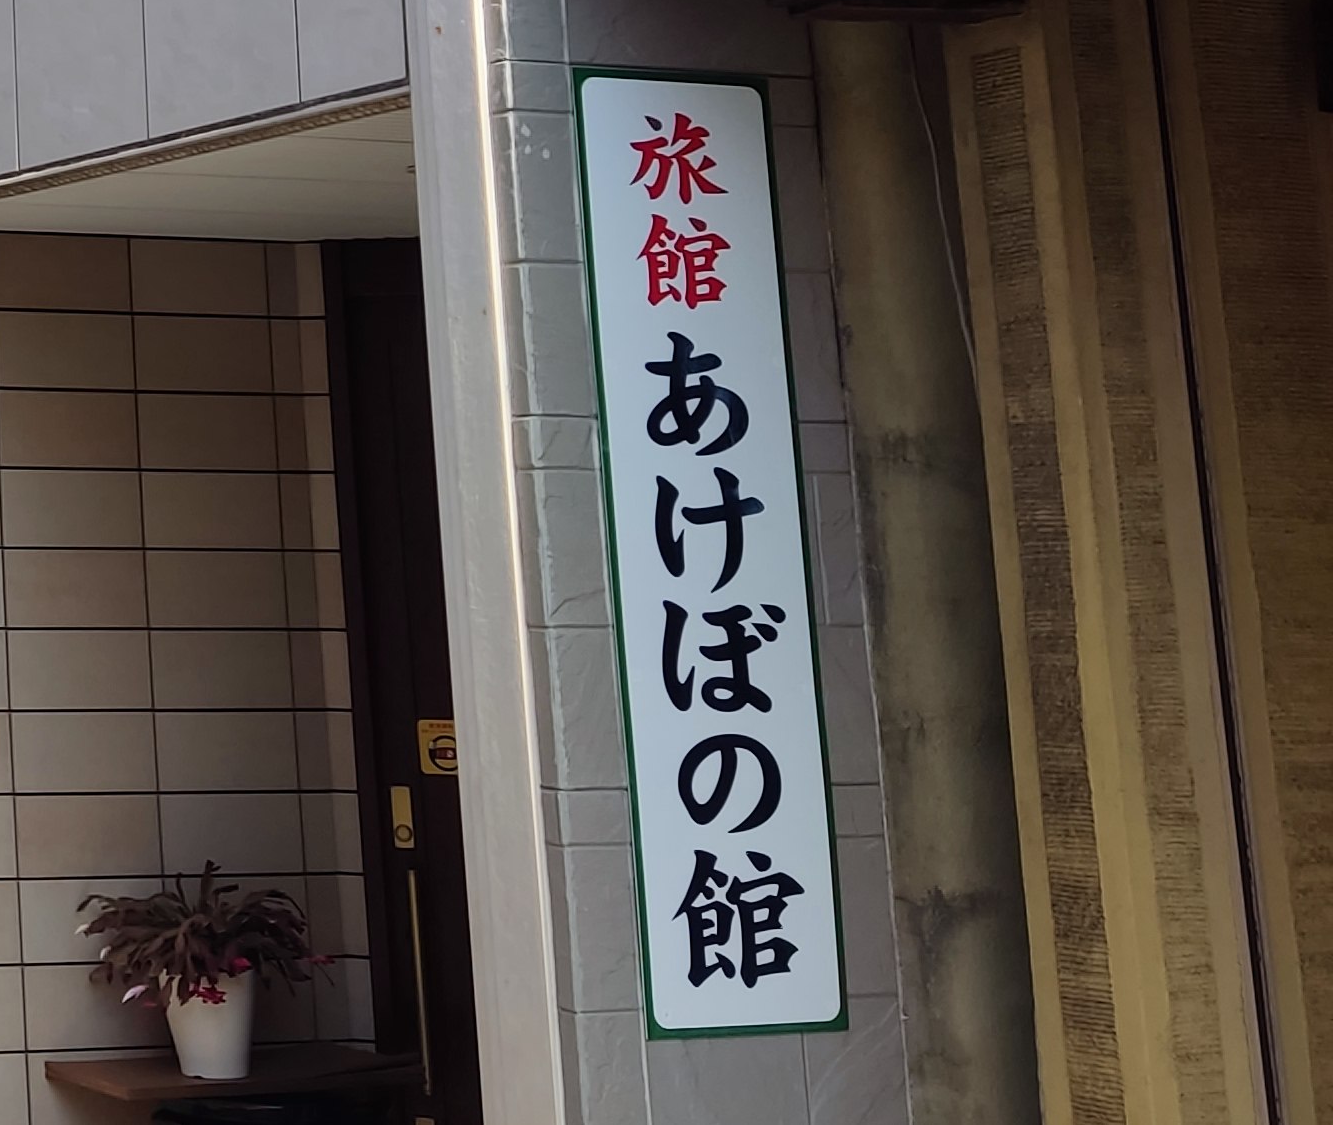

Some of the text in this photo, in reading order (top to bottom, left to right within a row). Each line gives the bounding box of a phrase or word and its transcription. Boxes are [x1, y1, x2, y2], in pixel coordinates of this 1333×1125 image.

[629, 112, 806, 989] 旅館 あけぼの館
